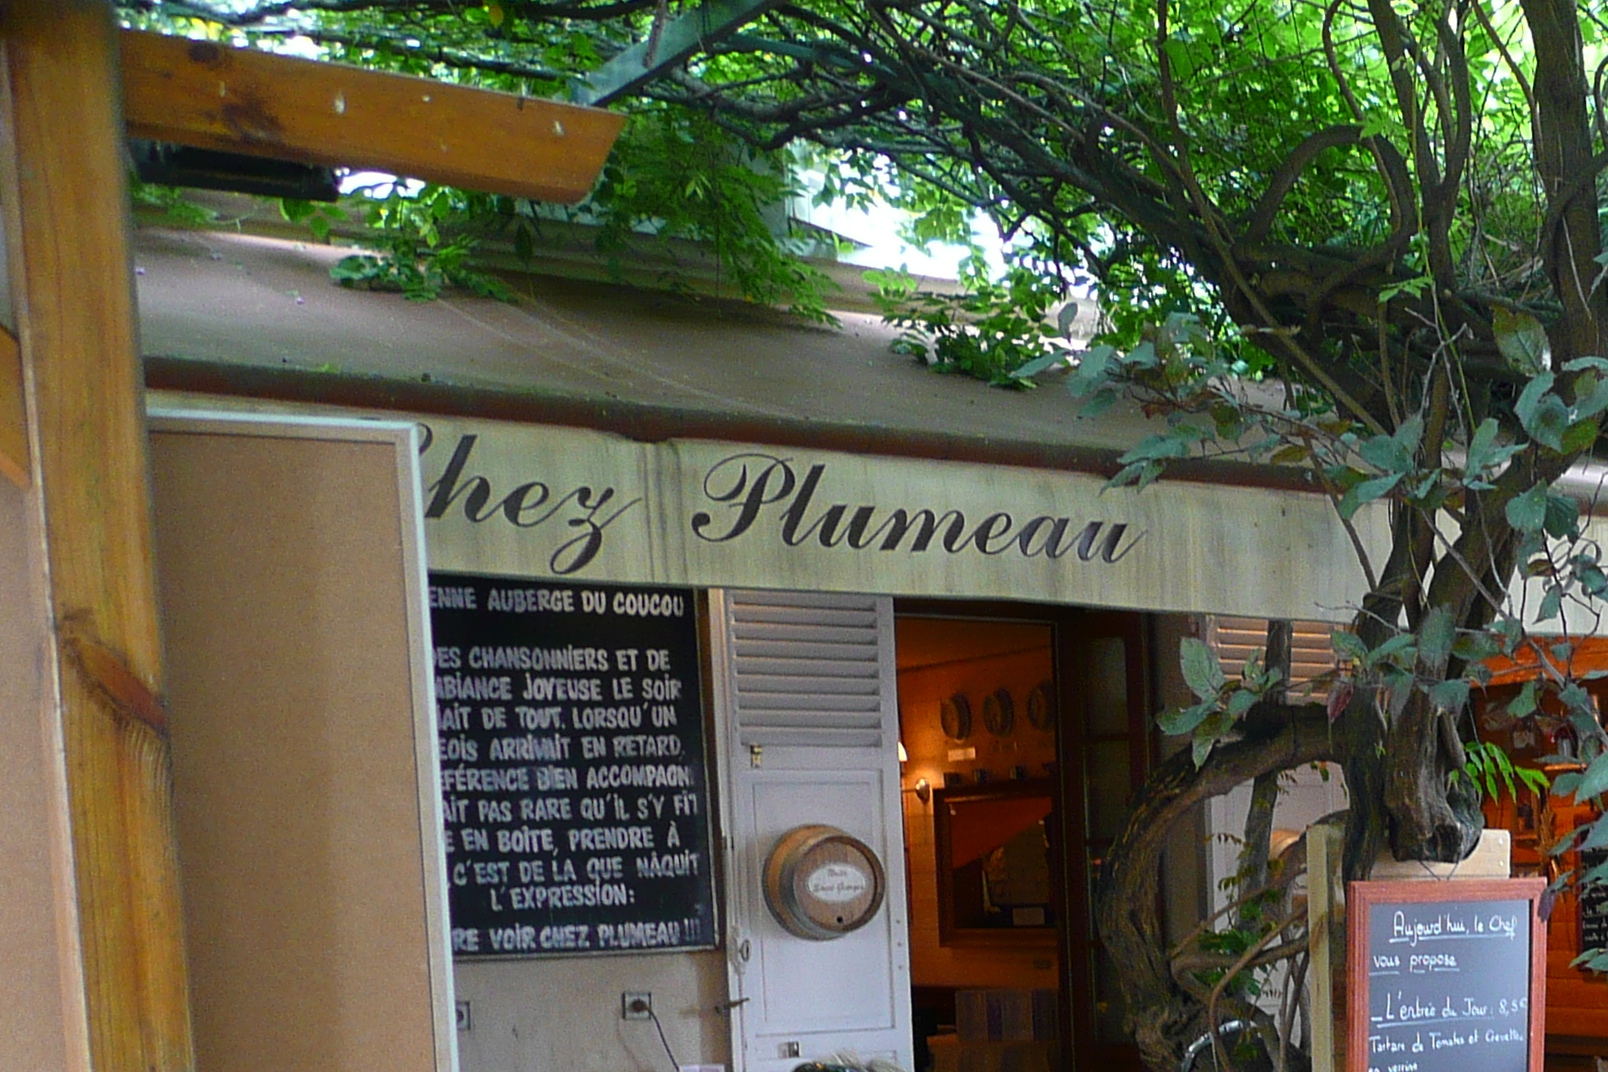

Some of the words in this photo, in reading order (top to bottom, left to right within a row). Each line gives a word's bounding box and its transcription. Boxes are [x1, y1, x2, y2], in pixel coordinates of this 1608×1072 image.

[422, 422, 641, 574] hez
[691, 452, 1147, 564] Plumeau
[488, 589, 574, 613] AUBERGE
[582, 594, 605, 613] DU
[613, 594, 683, 617] COUCOU
[434, 648, 461, 668] ES
[469, 644, 608, 671] CHANSONNIERS
[617, 650, 637, 671] ET
[647, 650, 670, 670] DE
[523, 676, 602, 701] JOYEUSE
[613, 679, 632, 701] LE
[642, 677, 681, 700] SOIR
[482, 708, 506, 729] DE
[518, 708, 566, 729] TOUT.
[490, 736, 572, 761] ARRIVAIT
[582, 737, 606, 758] EN
[538, 767, 577, 790] BIEN
[479, 801, 511, 822] PAS
[522, 801, 571, 819] RARE
[581, 797, 629, 822] QU'IL
[638, 793, 664, 818] S'Y
[463, 829, 488, 851] EN
[569, 829, 653, 853] PRENDRE
[668, 822, 679, 847] À
[520, 861, 543, 882] DE
[587, 858, 623, 881] QUE
[491, 879, 635, 911] L'EXPRESSION:
[489, 926, 535, 950] VOIR
[541, 928, 589, 948] CHEZ
[598, 923, 679, 947] PLUMEAU
[1475, 916, 1484, 934] le
[1490, 915, 1517, 940] Chef
[1410, 954, 1457, 972] propose
[1442, 999, 1457, 1017] du
[1413, 1032, 1424, 1052] de
[1469, 1029, 1478, 1045] et
